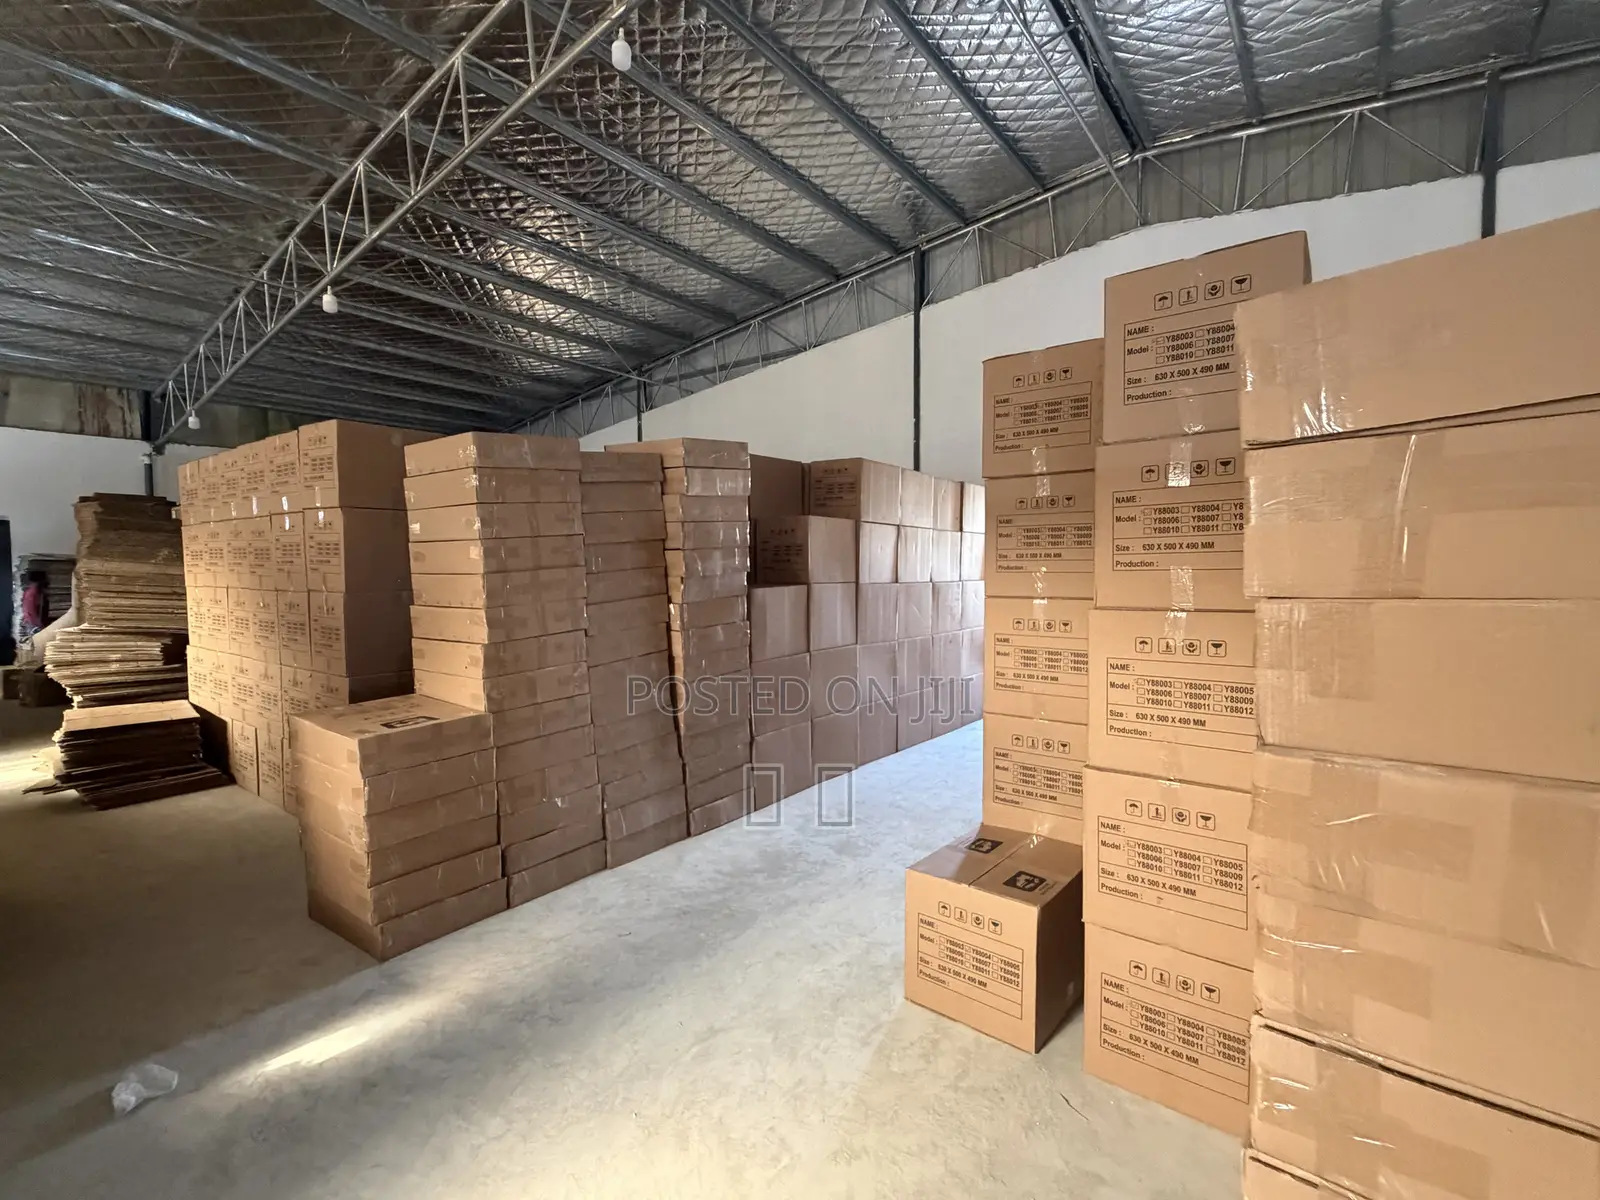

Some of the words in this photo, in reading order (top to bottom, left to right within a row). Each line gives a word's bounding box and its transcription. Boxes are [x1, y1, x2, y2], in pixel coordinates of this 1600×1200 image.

[1166, 332, 1194, 343] Y88003
[1166, 342, 1193, 352] Y88006
[1166, 352, 1193, 362] Y88010
[1177, 369, 1190, 377] 500
[1200, 365, 1213, 373] 490
[1153, 507, 1180, 515] Y88003
[1192, 504, 1220, 512] Y88004
[1153, 516, 1180, 524] Y88006
[1192, 514, 1220, 522] Y88007
[1153, 526, 1180, 534] Y88010
[1192, 524, 1219, 532] Y88011
[1146, 679, 1172, 688] Y88003
[1184, 682, 1211, 691] Y88004
[1224, 686, 1254, 695] Y88005
[1146, 688, 1172, 697] Y88006
[1184, 691, 1211, 701] Y88007
[1224, 695, 1254, 705] Y88009
[1146, 698, 1172, 707] Y88010
[1184, 702, 1211, 711] Y88011
[1224, 706, 1254, 715] Y88012
[1157, 715, 1169, 723] 500
[1178, 717, 1191, 725] 490
[1137, 842, 1162, 854] Y88003
[1174, 849, 1201, 861] Y88004
[1214, 858, 1243, 871] Y88005
[1137, 851, 1162, 863] Y88006
[1174, 859, 1201, 871] Y88007
[1214, 868, 1243, 881] Y88009
[1137, 860, 1162, 872] Y88010
[1174, 868, 1200, 881] Y88011
[1214, 878, 1243, 891] Y88012
[1127, 874, 1139, 883] 630
[1141, 876, 1146, 884] X
[1148, 878, 1160, 887] 500
[1169, 883, 1181, 893] 490
[1183, 887, 1196, 896] MM
[1140, 1002, 1166, 1019] Y88003
[1177, 1016, 1204, 1032] Y88004
[1217, 1030, 1246, 1046] Y88005
[1177, 1025, 1204, 1041] Y88007
[1129, 1034, 1141, 1044] 630
[1143, 1038, 1148, 1046] X
[1150, 1041, 1162, 1051] 500
[1164, 1046, 1169, 1054] X
[1171, 1048, 1184, 1059] 490
[1185, 1054, 1199, 1065] MM
[1140, 1022, 1166, 1037] Y88010
[1177, 1035, 1203, 1050] Y88011
[1216, 1049, 1246, 1065] Y88012
